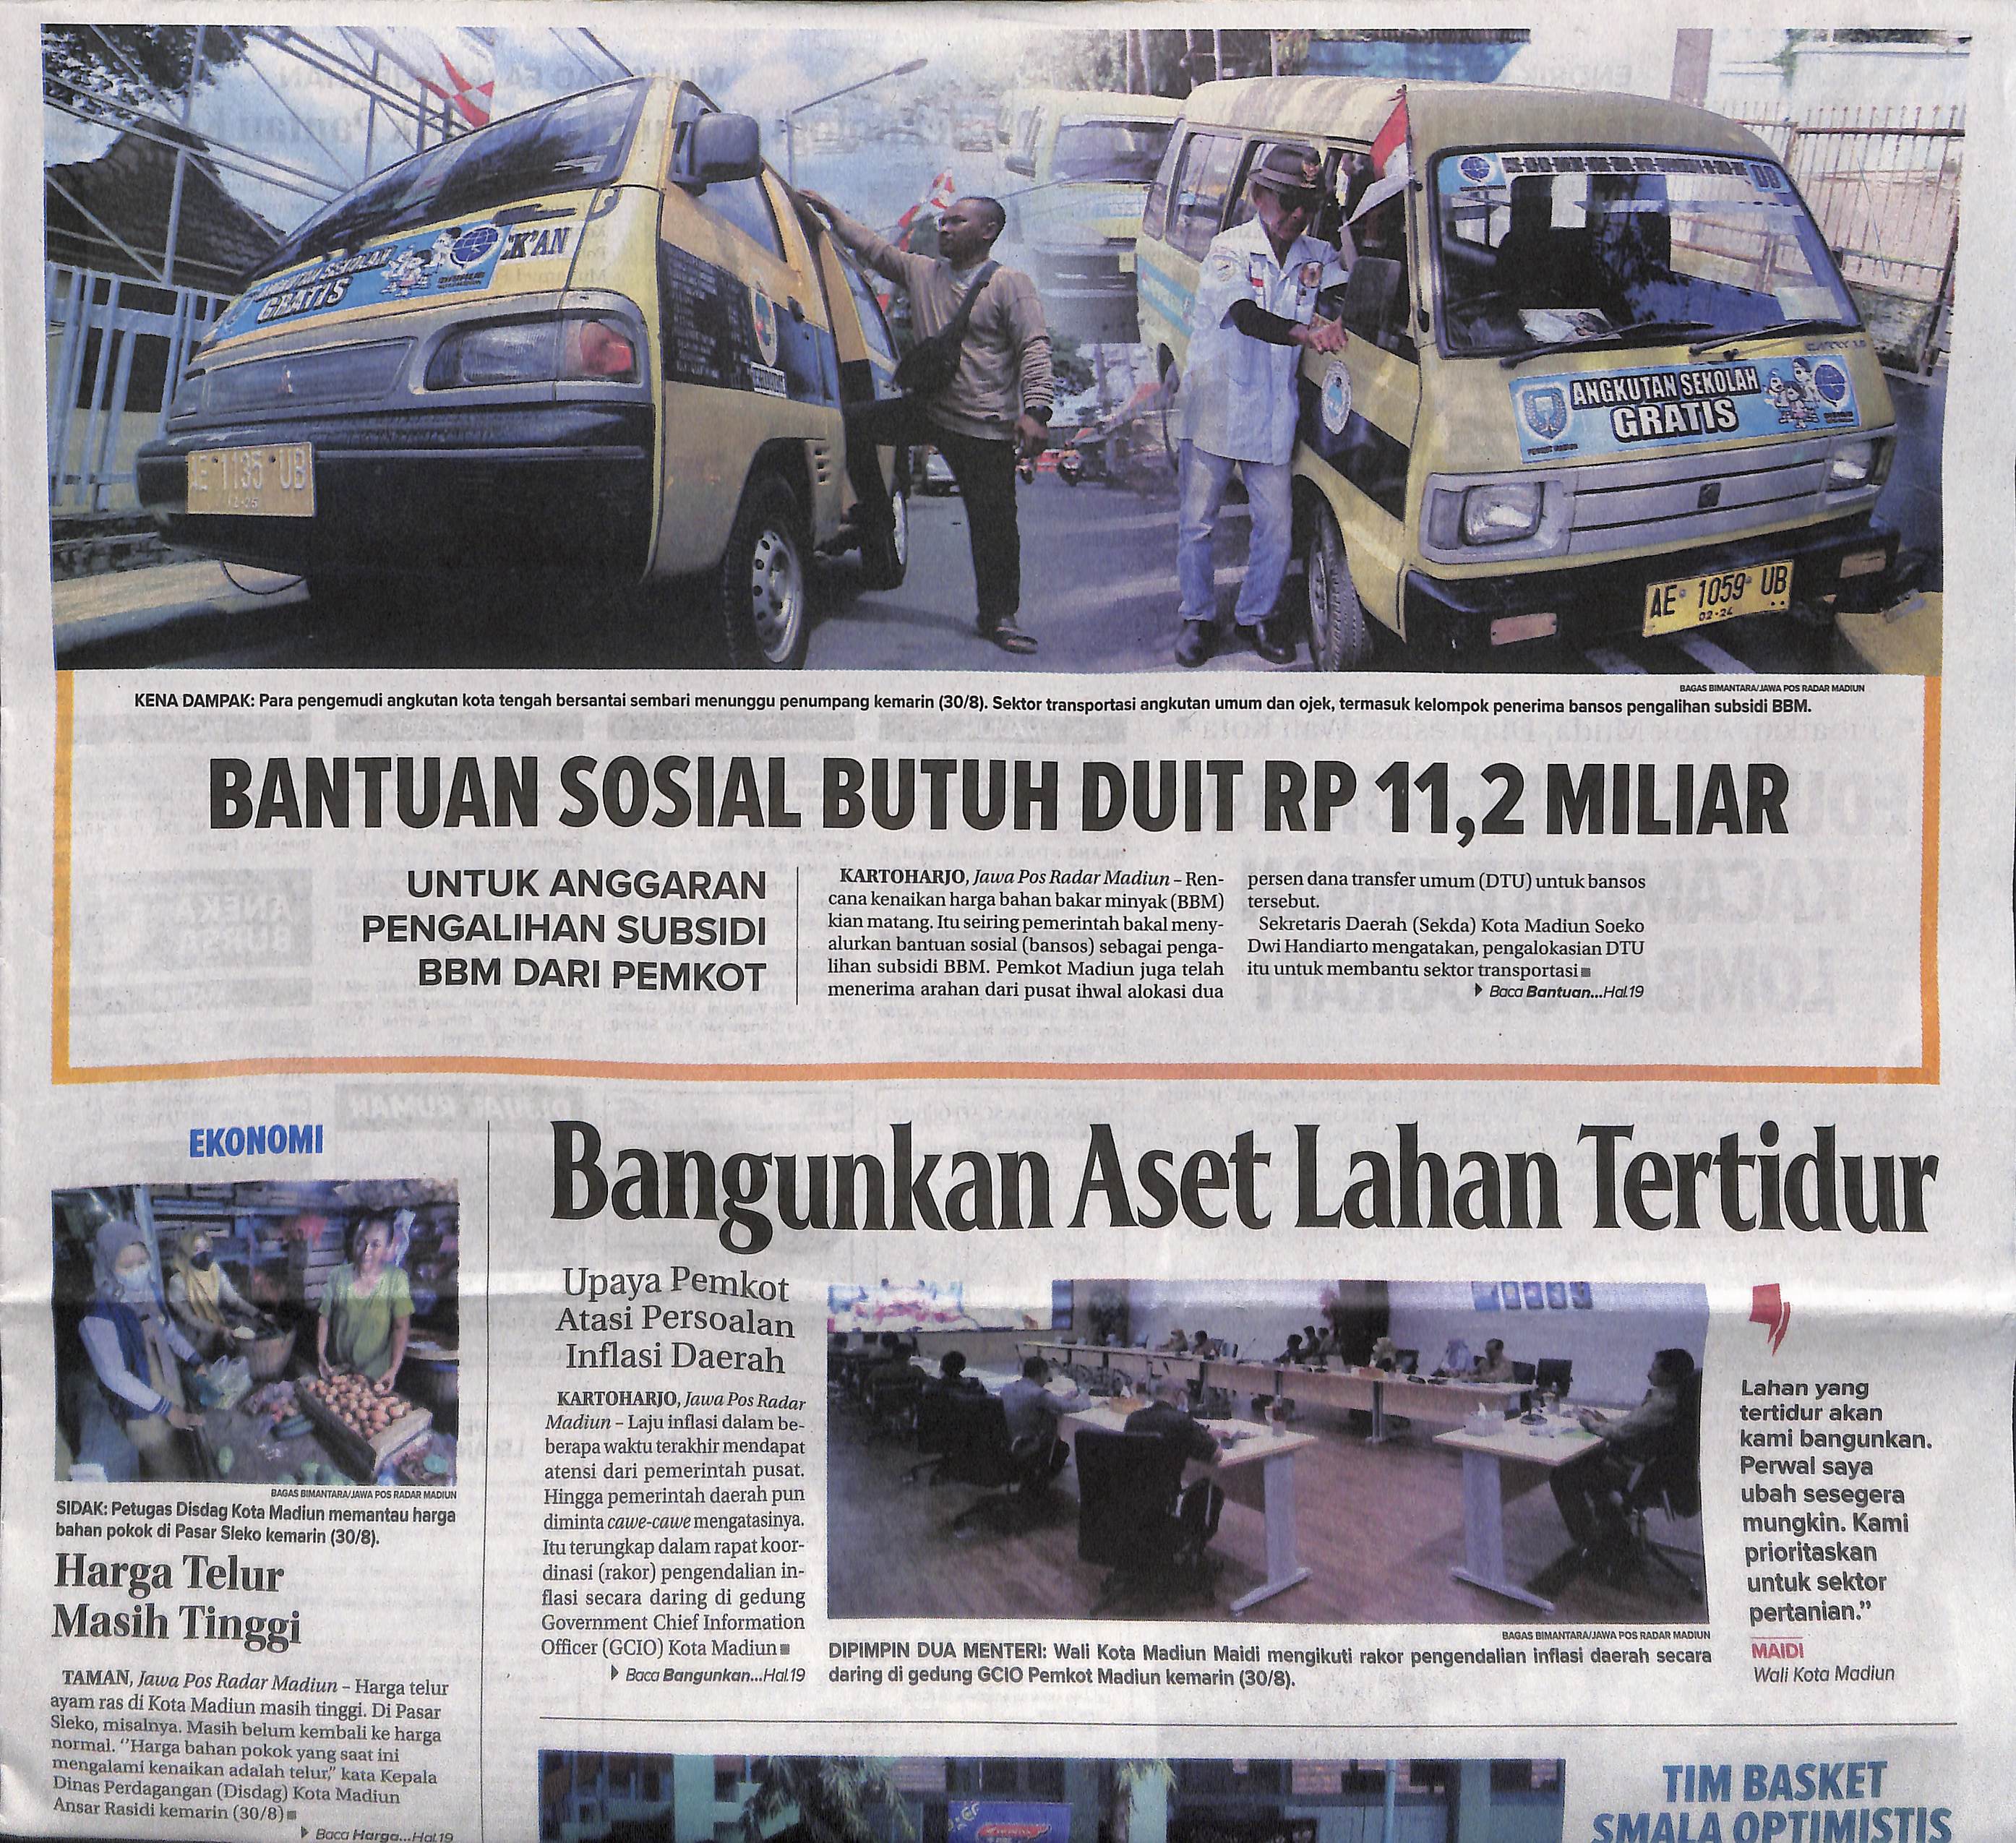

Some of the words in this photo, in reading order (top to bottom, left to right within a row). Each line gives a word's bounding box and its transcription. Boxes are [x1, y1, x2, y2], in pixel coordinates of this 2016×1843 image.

[257, 277, 352, 324] GRATIS
[1571, 372, 1677, 408] ANGKUTAN
[1681, 365, 1760, 397] SEKOLAH
[1613, 398, 1738, 440] GRATIS
[279, 448, 306, 490] UB
[1650, 584, 1678, 619] AE
[1698, 572, 1746, 609] 1059
[1761, 565, 1788, 596] UB
[1679, 684, 1707, 692] BAGAS
[134, 693, 179, 708] KENA
[182, 693, 255, 708] DAMPAK:
[259, 693, 293, 708] Para
[298, 692, 383, 710] pengemudi
[387, 692, 458, 710] angkutan
[463, 692, 495, 707] kota
[498, 692, 552, 710] tengah
[556, 692, 626, 707] bersantai
[630, 692, 690, 707] sembari
[695, 696, 776, 710] menunggu
[780, 697, 870, 711] penumpang
[874, 694, 935, 709] kemarin
[938, 695, 988, 713] (30/8).
[992, 695, 1042, 711] Sektor
[1045, 697, 1136, 716] transportasi
[1140, 696, 1211, 713] angkutan
[1215, 699, 1262, 710] umum
[1266, 696, 1295, 710] dan
[1299, 695, 1335, 714] ojek,
[1339, 697, 1411, 711] termasuk
[1415, 697, 1490, 716] kelompok
[1493, 698, 1564, 716] penerima
[1569, 699, 1623, 713] bansos
[1626, 698, 1710, 717] pengalihan
[1714, 698, 1768, 713] subsidi
[1772, 698, 1812, 713] BBM.
[210, 756, 539, 830] BANTUAN
[558, 755, 802, 828] SOSIAL
[823, 757, 1058, 831] BUTUH
[1081, 760, 1244, 833] DUIT
[1264, 760, 1357, 832] RP
[1374, 761, 1524, 849] 11,2
[1546, 762, 1789, 835] MILIAR
[408, 869, 540, 898] UNTUK
[549, 869, 765, 900] ANGGARAN
[839, 868, 969, 887] KARTOHARJO,
[971, 869, 1015, 886] Jawa
[1017, 869, 1047, 885] Pos
[1048, 869, 1102, 885] Radar
[1102, 869, 1170, 886] Madiun
[1185, 872, 1224, 887] Ren-
[363, 914, 605, 943] PENGALIHAN
[617, 915, 765, 946] SUBSIDI
[1259, 915, 1341, 931] Sekretaris
[1345, 916, 1408, 932] Daerah
[1412, 916, 1476, 936] (Sekda)
[1481, 918, 1520, 933] Kota
[1524, 918, 1591, 933] Madiun
[1595, 918, 1644, 934] Soeko
[419, 957, 501, 986] BBM
[514, 958, 600, 988] DARI
[613, 961, 767, 992] PEMKOT
[1489, 984, 1524, 998] Baca
[189, 1124, 323, 1158] EKONOMI
[549, 1120, 1055, 1255] Bangunkan
[1066, 1123, 1272, 1230] Aset
[1294, 1120, 1564, 1230] Lahan
[1577, 1120, 1939, 1234] Tertidur
[562, 1267, 662, 1302] Upaya
[670, 1266, 789, 1302] Pemkot
[554, 1305, 633, 1331] Atasi
[641, 1305, 796, 1339] Persoalan
[566, 1341, 663, 1369] Inflasi
[671, 1341, 786, 1374] Daerah
[557, 1391, 681, 1409] KARTOHARJO,
[683, 1391, 724, 1409] Jawa
[726, 1391, 755, 1407] Pos
[756, 1393, 807, 1411] Radar
[1741, 1379, 1809, 1396] Lahan
[1814, 1382, 1869, 1401] yang
[1739, 1403, 1823, 1422] tertidur
[1829, 1404, 1883, 1422] akan
[1740, 1428, 1793, 1448] kami
[1800, 1429, 1932, 1453] bangunkan.
[270, 1488, 299, 1498] BAGAS
[374, 1490, 392, 1499] POS
[393, 1490, 421, 1499] RADAR
[423, 1490, 457, 1500] MADIUN
[56, 1500, 108, 1516] SIDAK:
[111, 1501, 173, 1520] Petugas
[176, 1500, 228, 1521] Disdag
[231, 1503, 265, 1520] Kota
[269, 1504, 325, 1521] Madiun
[328, 1507, 409, 1523] memantau
[413, 1506, 456, 1526] harga
[56, 1521, 102, 1538] bahan
[106, 1522, 153, 1541] pokok
[156, 1522, 171, 1538] di
[175, 1523, 217, 1539] Pasar
[220, 1524, 262, 1542] Sleko
[266, 1526, 326, 1544] kemarin
[330, 1528, 380, 1549] (30/8).
[53, 1552, 173, 1600] Harga
[182, 1554, 285, 1592] Telur
[51, 1602, 170, 1640] Masih
[179, 1604, 301, 1654] Tinggi
[541, 1614, 648, 1631] Government
[653, 1612, 700, 1631] Chief
[703, 1612, 805, 1631] Information
[1502, 1631, 1534, 1641] BAGAS
[1618, 1631, 1638, 1640] POS
[1639, 1631, 1671, 1640] RADAR
[1673, 1631, 1711, 1640] MADIUN
[1751, 1642, 1805, 1659] MAIDI
[625, 1667, 660, 1683] Baca
[828, 1665, 883, 1686] daring
[888, 1665, 904, 1683] di
[908, 1665, 973, 1686] gedung
[977, 1665, 1024, 1683] GCIO
[1028, 1666, 1094, 1684] Pemkot
[1097, 1667, 1161, 1685] Madiun
[1166, 1668, 1235, 1686] kemarin
[1239, 1670, 1295, 1691] (30/8).
[1754, 1666, 1789, 1683] Wali
[1793, 1667, 1830, 1683] Kota
[1835, 1664, 1895, 1682] Madiun
[1662, 1764, 1732, 1803] TIM
[1743, 1760, 1888, 1802] BASKET
[53, 1796, 100, 1815] Ansar
[103, 1801, 155, 1817] Rasidi
[159, 1803, 229, 1820] kemarin
[233, 1804, 284, 1823] (30/8)
[1590, 1810, 1723, 1843] SMALA
[1732, 1806, 1952, 1843] OPTIMISTIS
